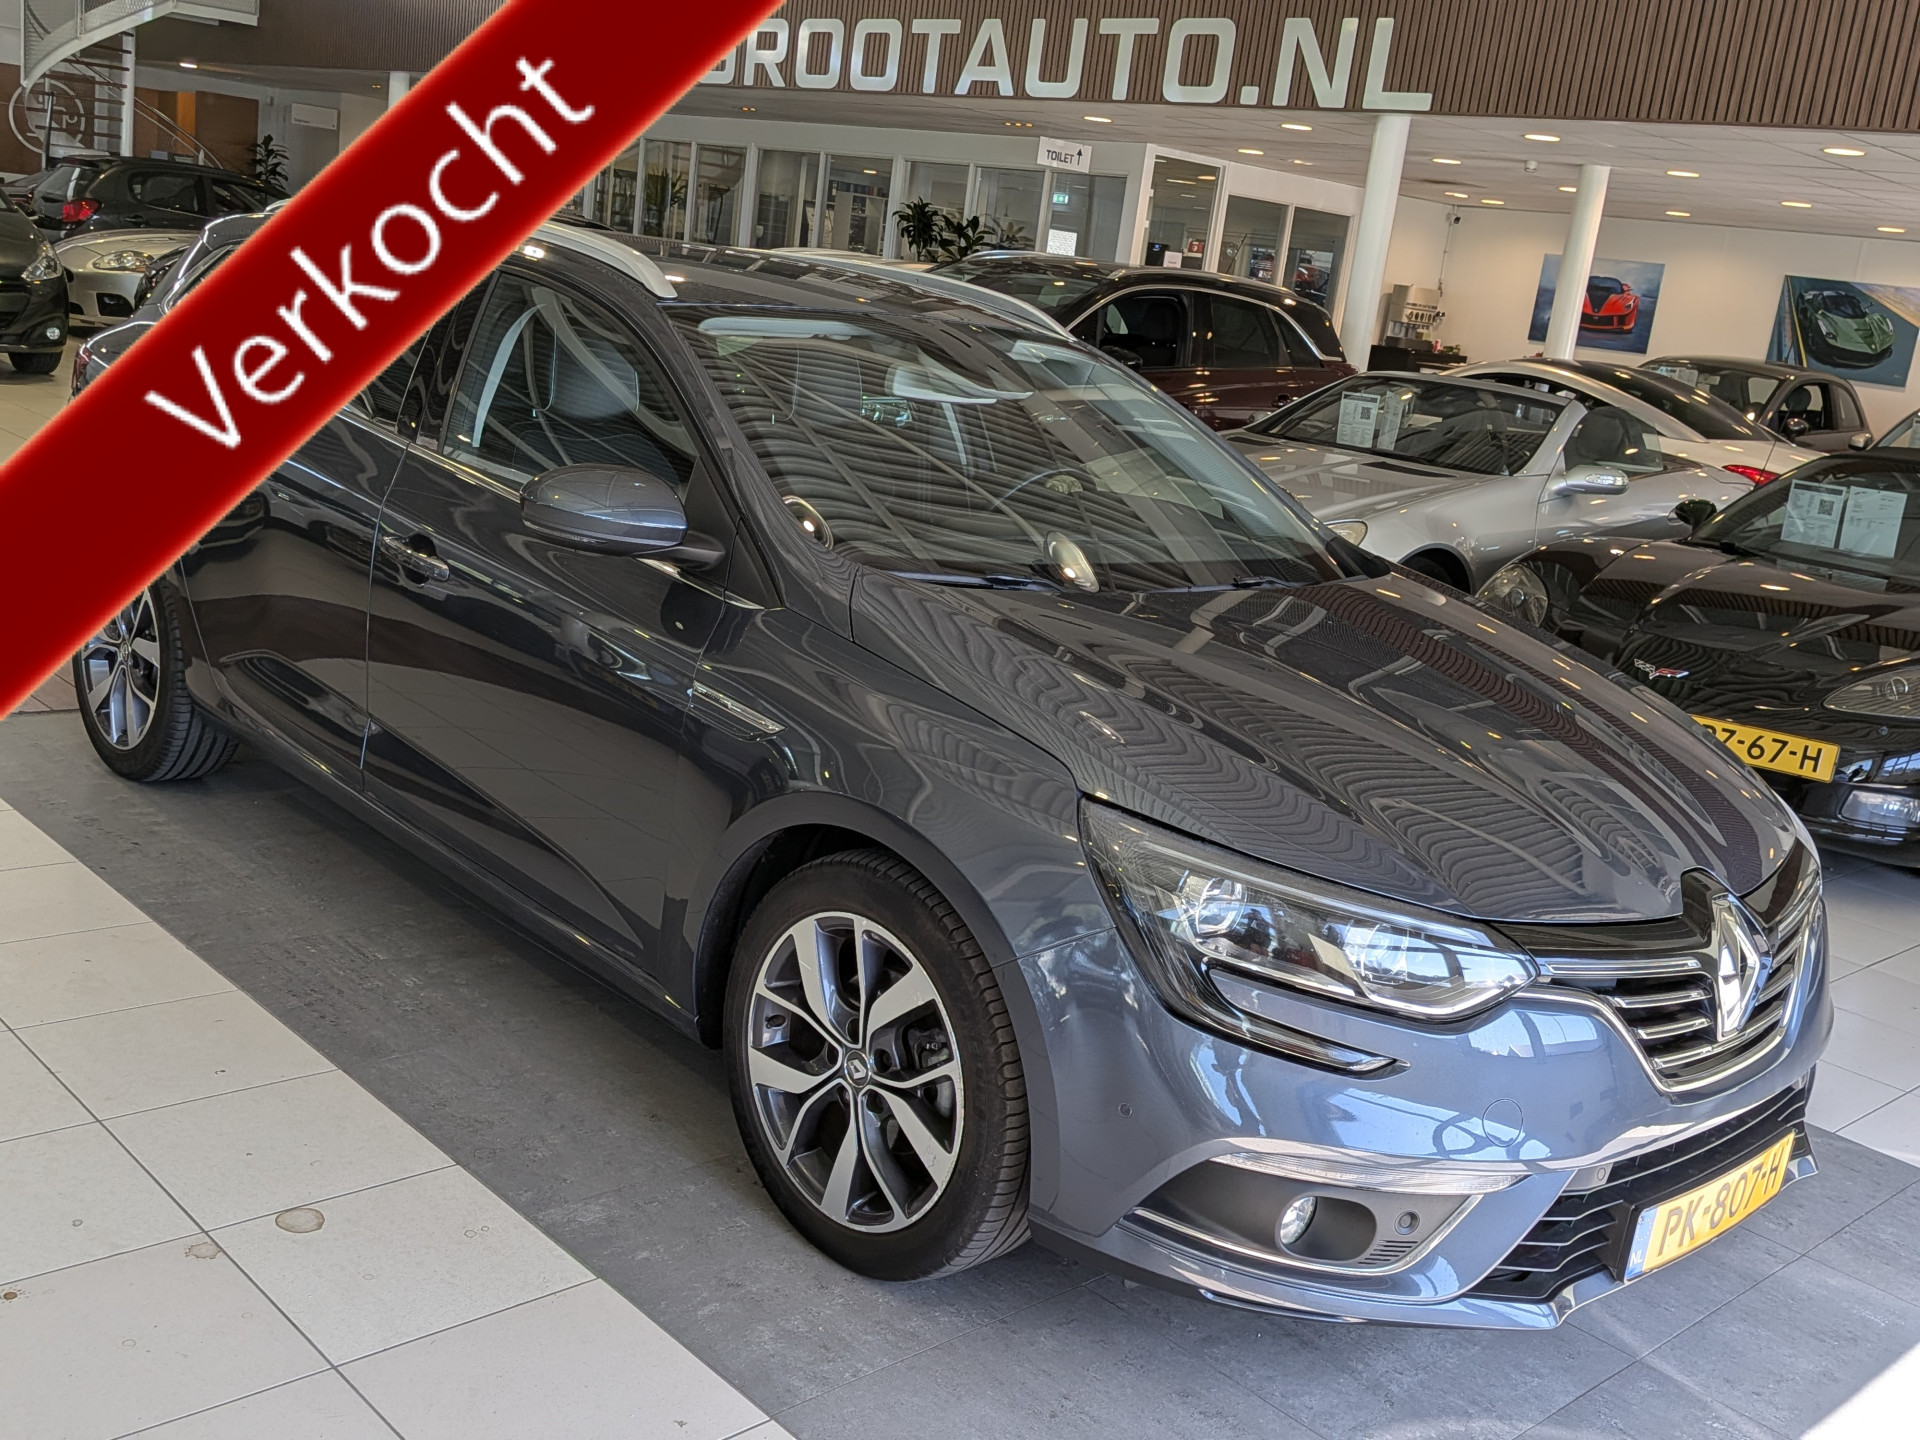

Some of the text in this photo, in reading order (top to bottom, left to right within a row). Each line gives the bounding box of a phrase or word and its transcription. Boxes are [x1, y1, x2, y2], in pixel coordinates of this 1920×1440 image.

[1046, 149, 1075, 165] TOILET
[1656, 1145, 1787, 1257] PK-807-H
[1629, 1249, 1643, 1267] NL
